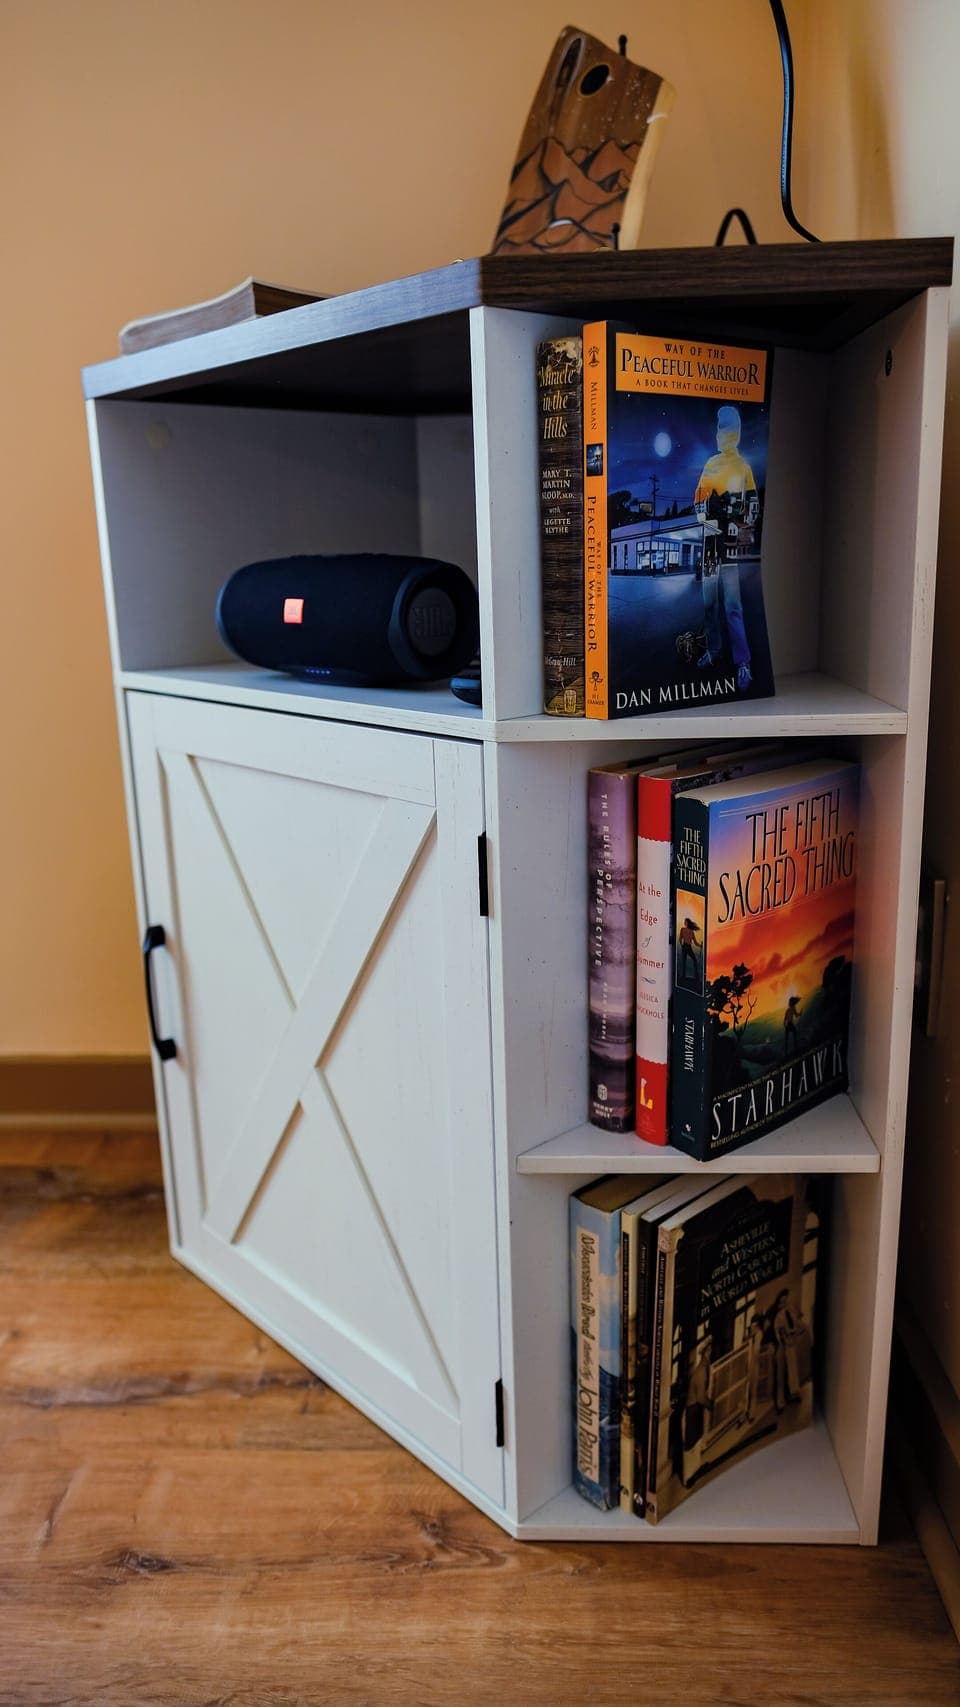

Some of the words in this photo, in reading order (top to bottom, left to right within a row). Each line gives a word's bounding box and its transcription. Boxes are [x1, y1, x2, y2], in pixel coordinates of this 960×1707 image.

[664, 343, 685, 354] WAY
[690, 346, 703, 356] OF
[708, 349, 726, 360] THE
[621, 348, 694, 379] PEACEFUL
[697, 362, 761, 386] WARRIOR
[645, 379, 669, 388] BOOK
[672, 381, 691, 391] THAT
[694, 384, 728, 394] CHANGES
[729, 388, 749, 396] LIVES
[553, 390, 569, 410] the
[590, 381, 598, 430] MILLMAN
[543, 416, 568, 439] Hills
[542, 469, 560, 479] MARY
[542, 480, 570, 489] MARTIN
[587, 496, 597, 572] PEACEFUL
[587, 580, 597, 652] WARRIOR
[616, 688, 651, 709] DAN
[659, 677, 736, 704] MILLMAN
[600, 793, 609, 817] THE
[683, 827, 701, 845] THE
[745, 805, 789, 863] THE
[795, 788, 841, 850] FIFTH
[603, 825, 612, 866] RULES
[680, 840, 704, 859] FIFTH
[676, 853, 706, 873] SACRED
[605, 873, 613, 889] OF
[677, 867, 705, 888] THING
[717, 856, 796, 923] SACRED
[802, 831, 854, 896] THING
[647, 884, 662, 898] the
[595, 868, 604, 966] PERSPECTIVE
[640, 908, 658, 927] Edge
[684, 1017, 695, 1072] STARHAWK
[712, 1040, 842, 1141] STARHAWK
[579, 1378, 597, 1427] John
